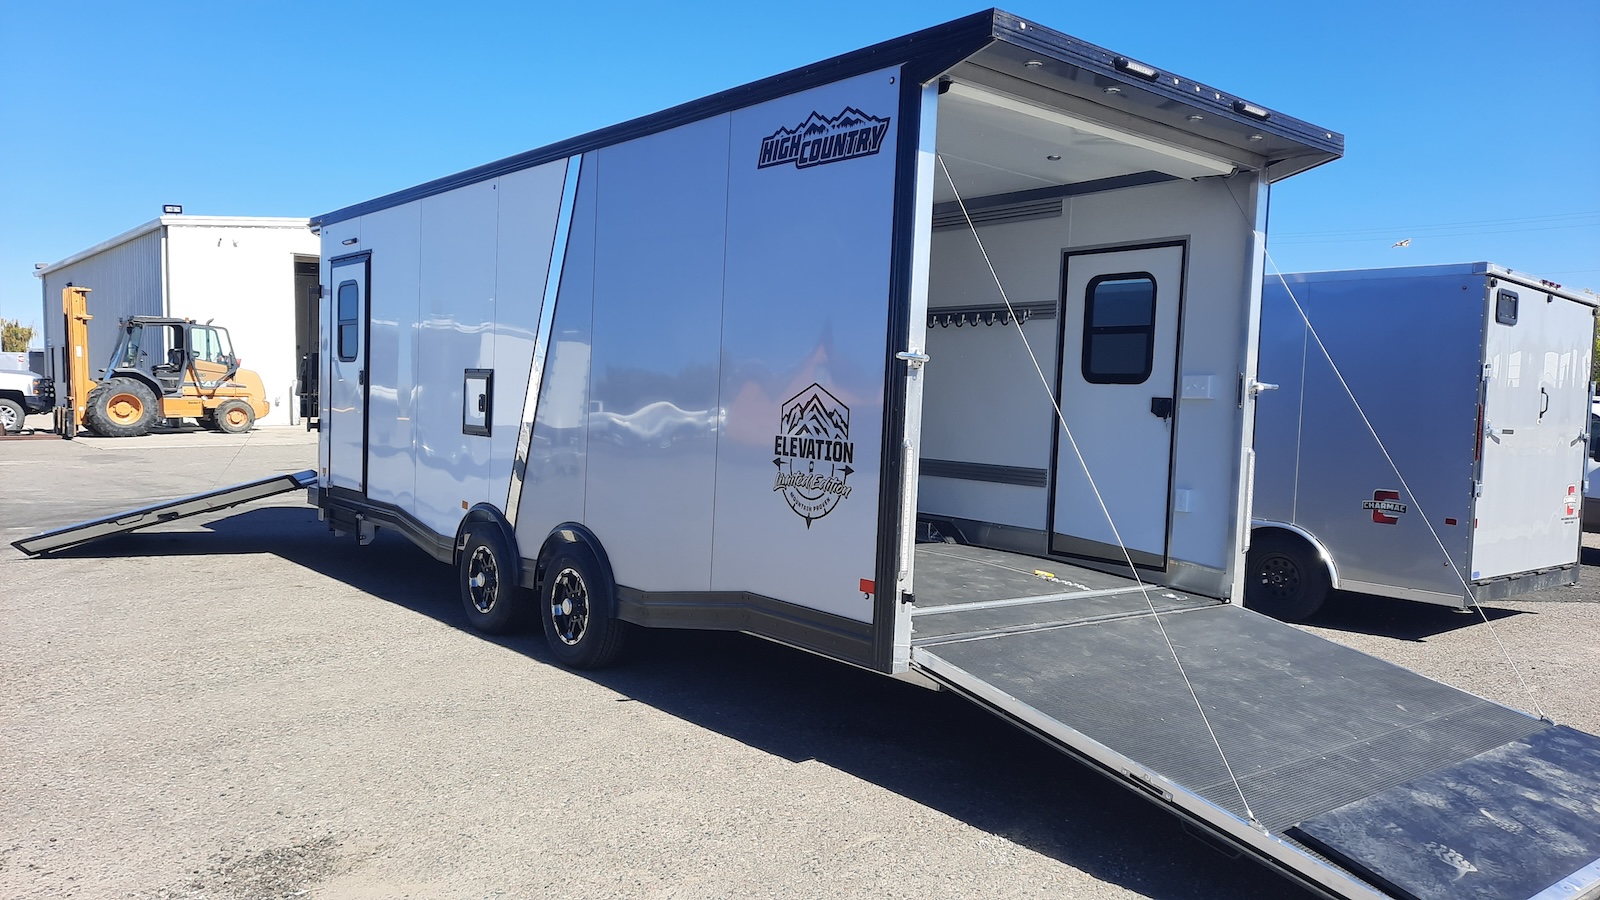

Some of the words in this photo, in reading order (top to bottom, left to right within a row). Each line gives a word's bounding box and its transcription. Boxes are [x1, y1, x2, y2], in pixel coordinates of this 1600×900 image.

[761, 133, 803, 164] HIGH
[798, 122, 886, 164] COUNTRY
[774, 435, 854, 464] ELEVATION
[773, 470, 813, 492] Limited
[810, 474, 852, 499] Edition
[790, 491, 812, 512] MOUNTAIN
[813, 496, 831, 511] PROVEN
[1363, 501, 1406, 512] CHARMAC
